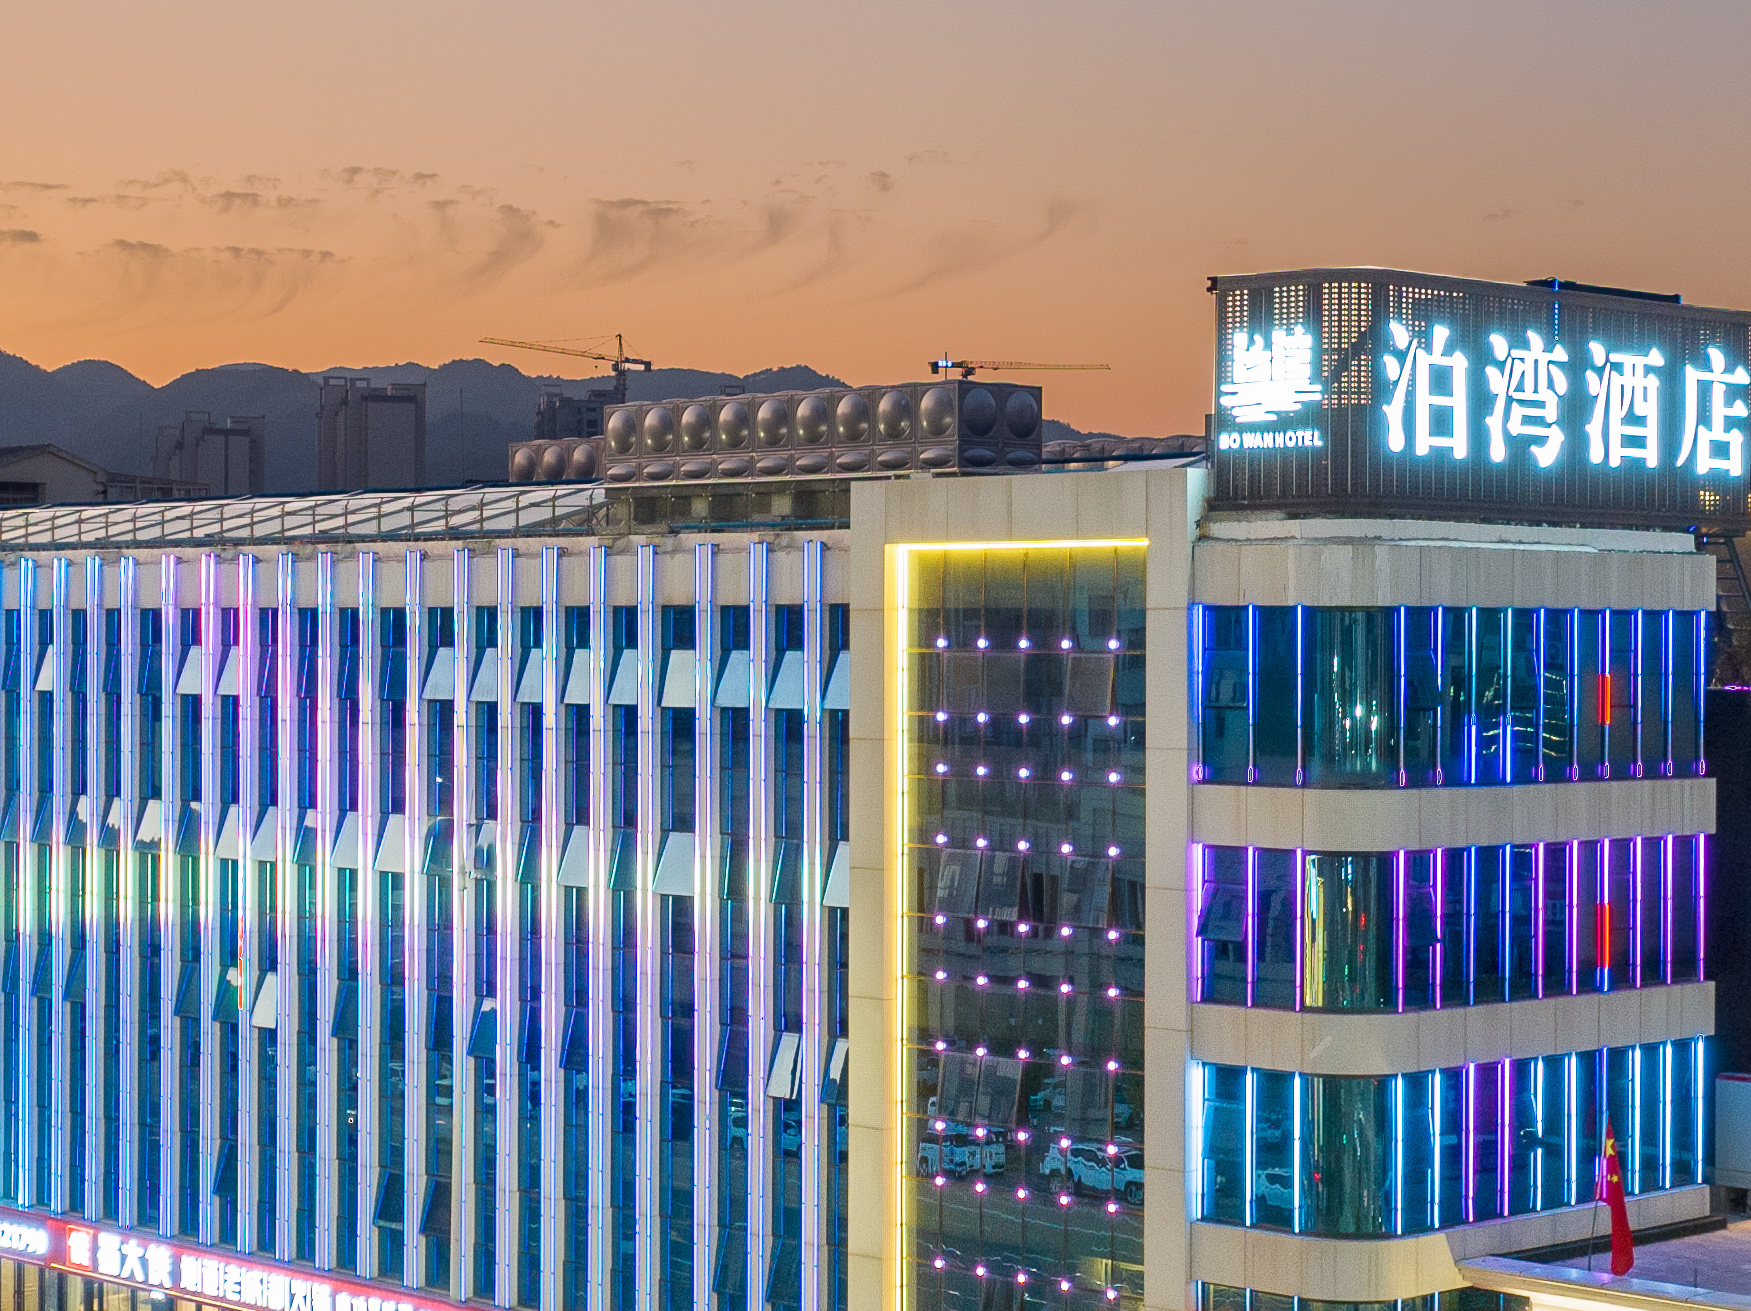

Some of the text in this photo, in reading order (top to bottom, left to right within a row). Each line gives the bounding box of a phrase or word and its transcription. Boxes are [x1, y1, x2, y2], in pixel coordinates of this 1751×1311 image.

[1219, 429, 1323, 449] BO WAN HOTEL
[1382, 320, 1750, 478] 泊湾酒店
